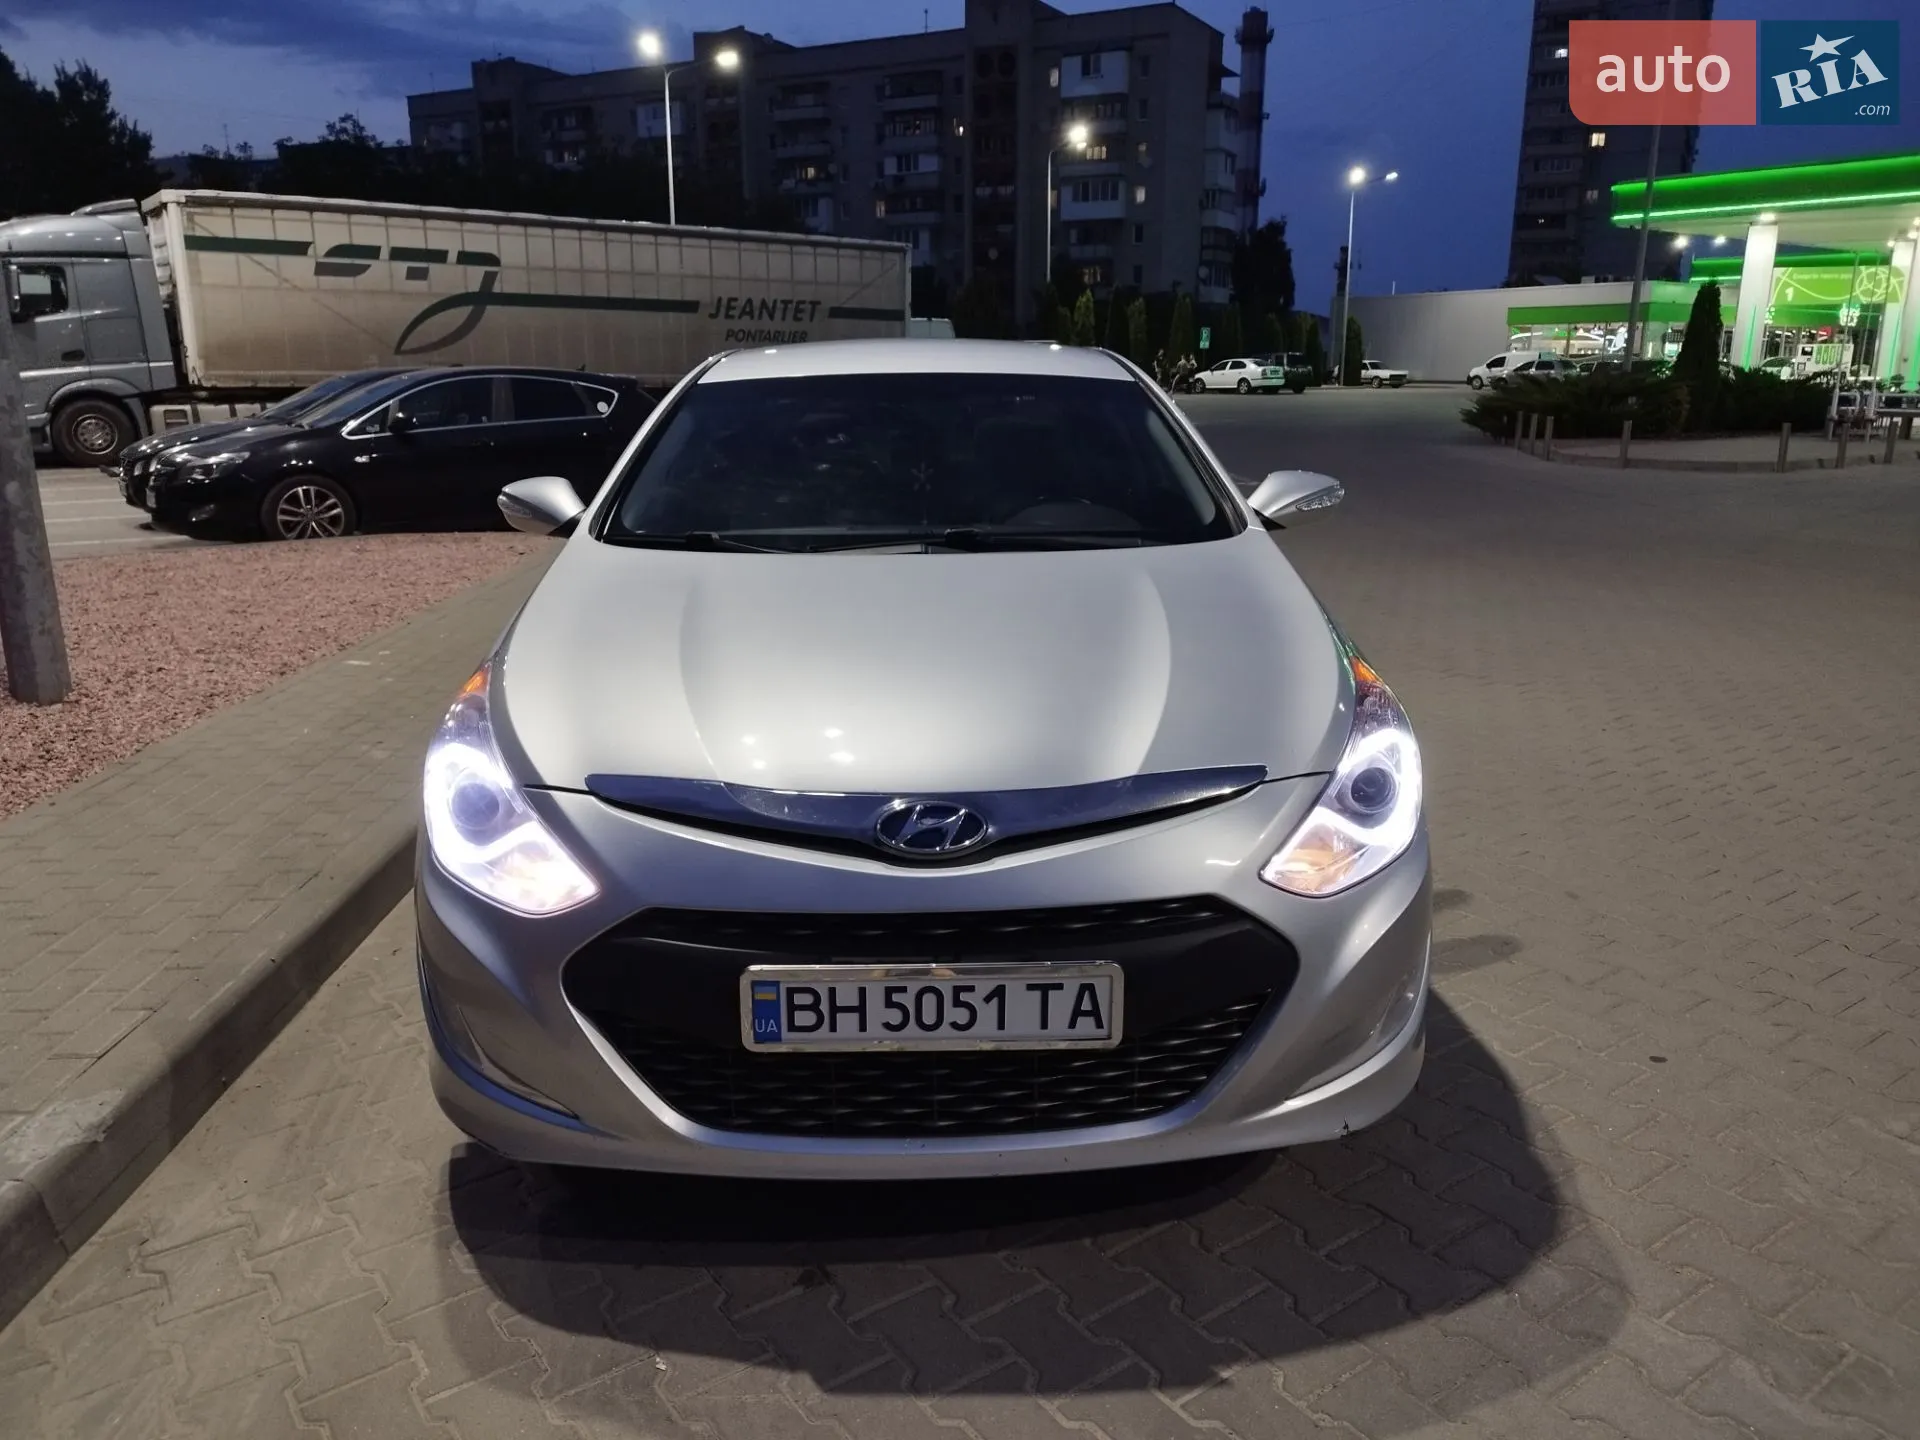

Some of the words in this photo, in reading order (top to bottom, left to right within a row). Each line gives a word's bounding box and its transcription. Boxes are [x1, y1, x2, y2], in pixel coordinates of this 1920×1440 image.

[708, 296, 822, 323] JEANTET
[725, 328, 808, 344] PONTARLIER
[755, 1018, 778, 1033] UA
[786, 985, 867, 1033] BH
[881, 984, 1006, 1033] 5051
[1026, 982, 1105, 1030] TA
